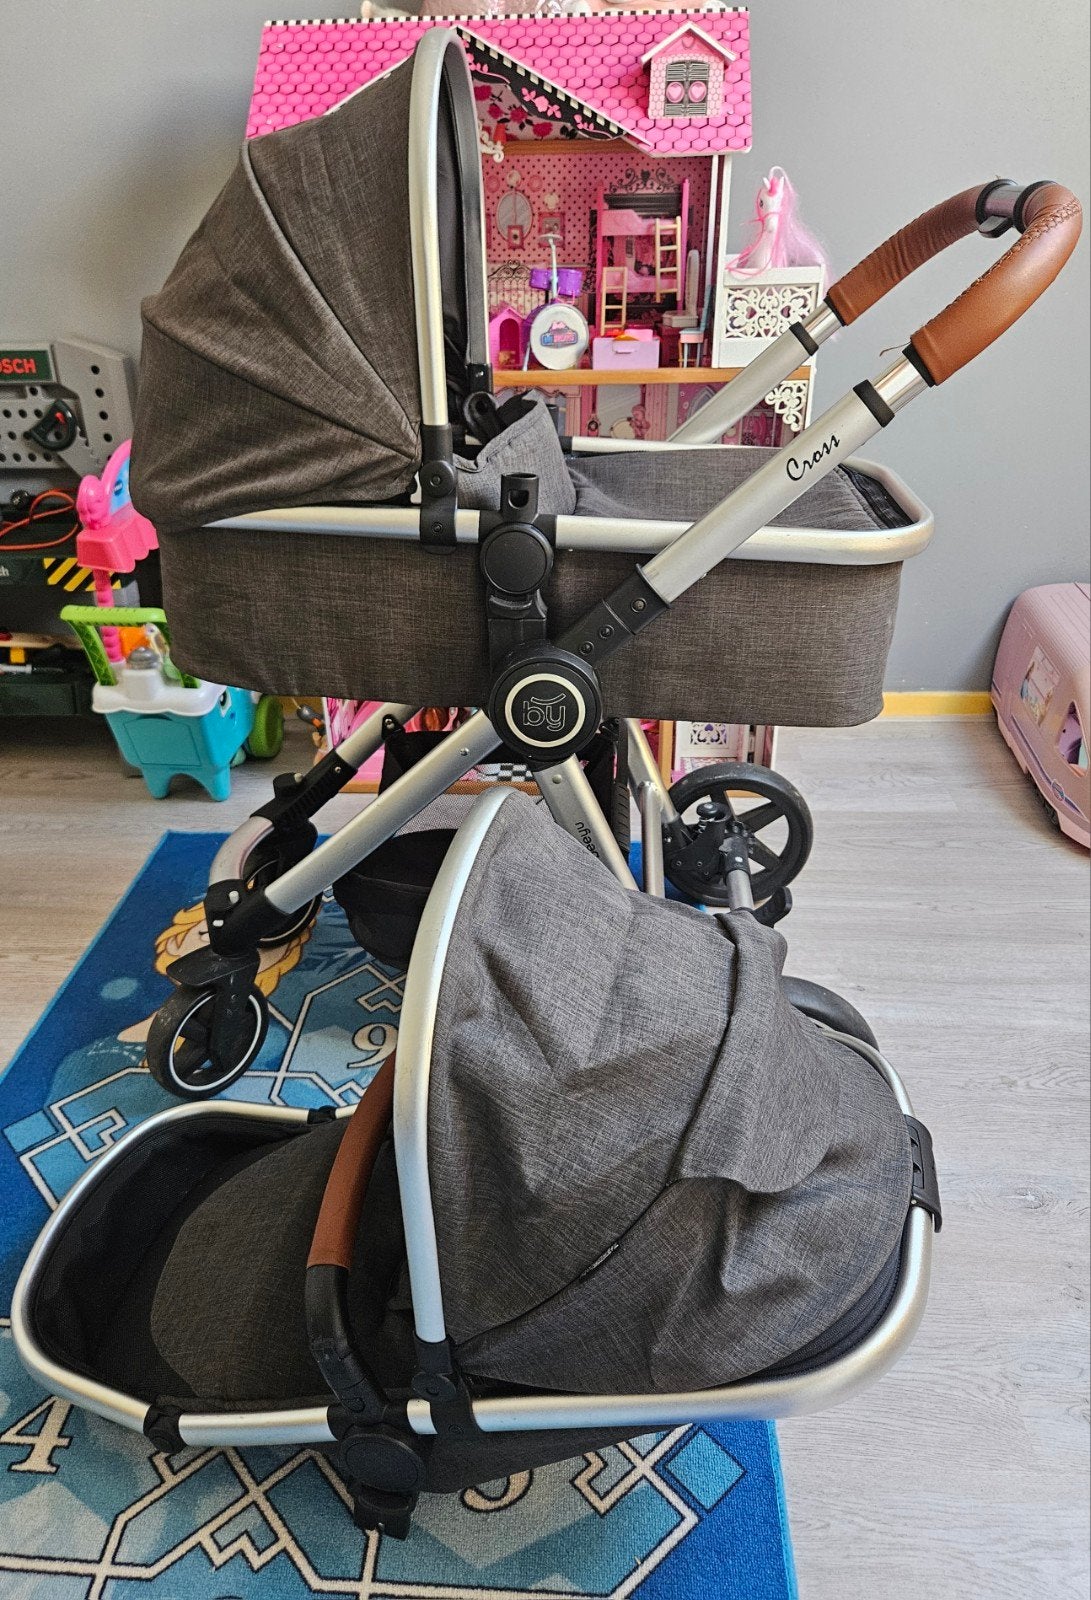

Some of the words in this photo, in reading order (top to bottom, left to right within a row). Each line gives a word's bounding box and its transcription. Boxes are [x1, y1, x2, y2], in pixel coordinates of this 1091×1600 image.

[0, 358, 37, 374] SCH
[786, 435, 840, 481] Cross
[347, 1022, 399, 1069] 9
[0, 1394, 74, 1475] 4
